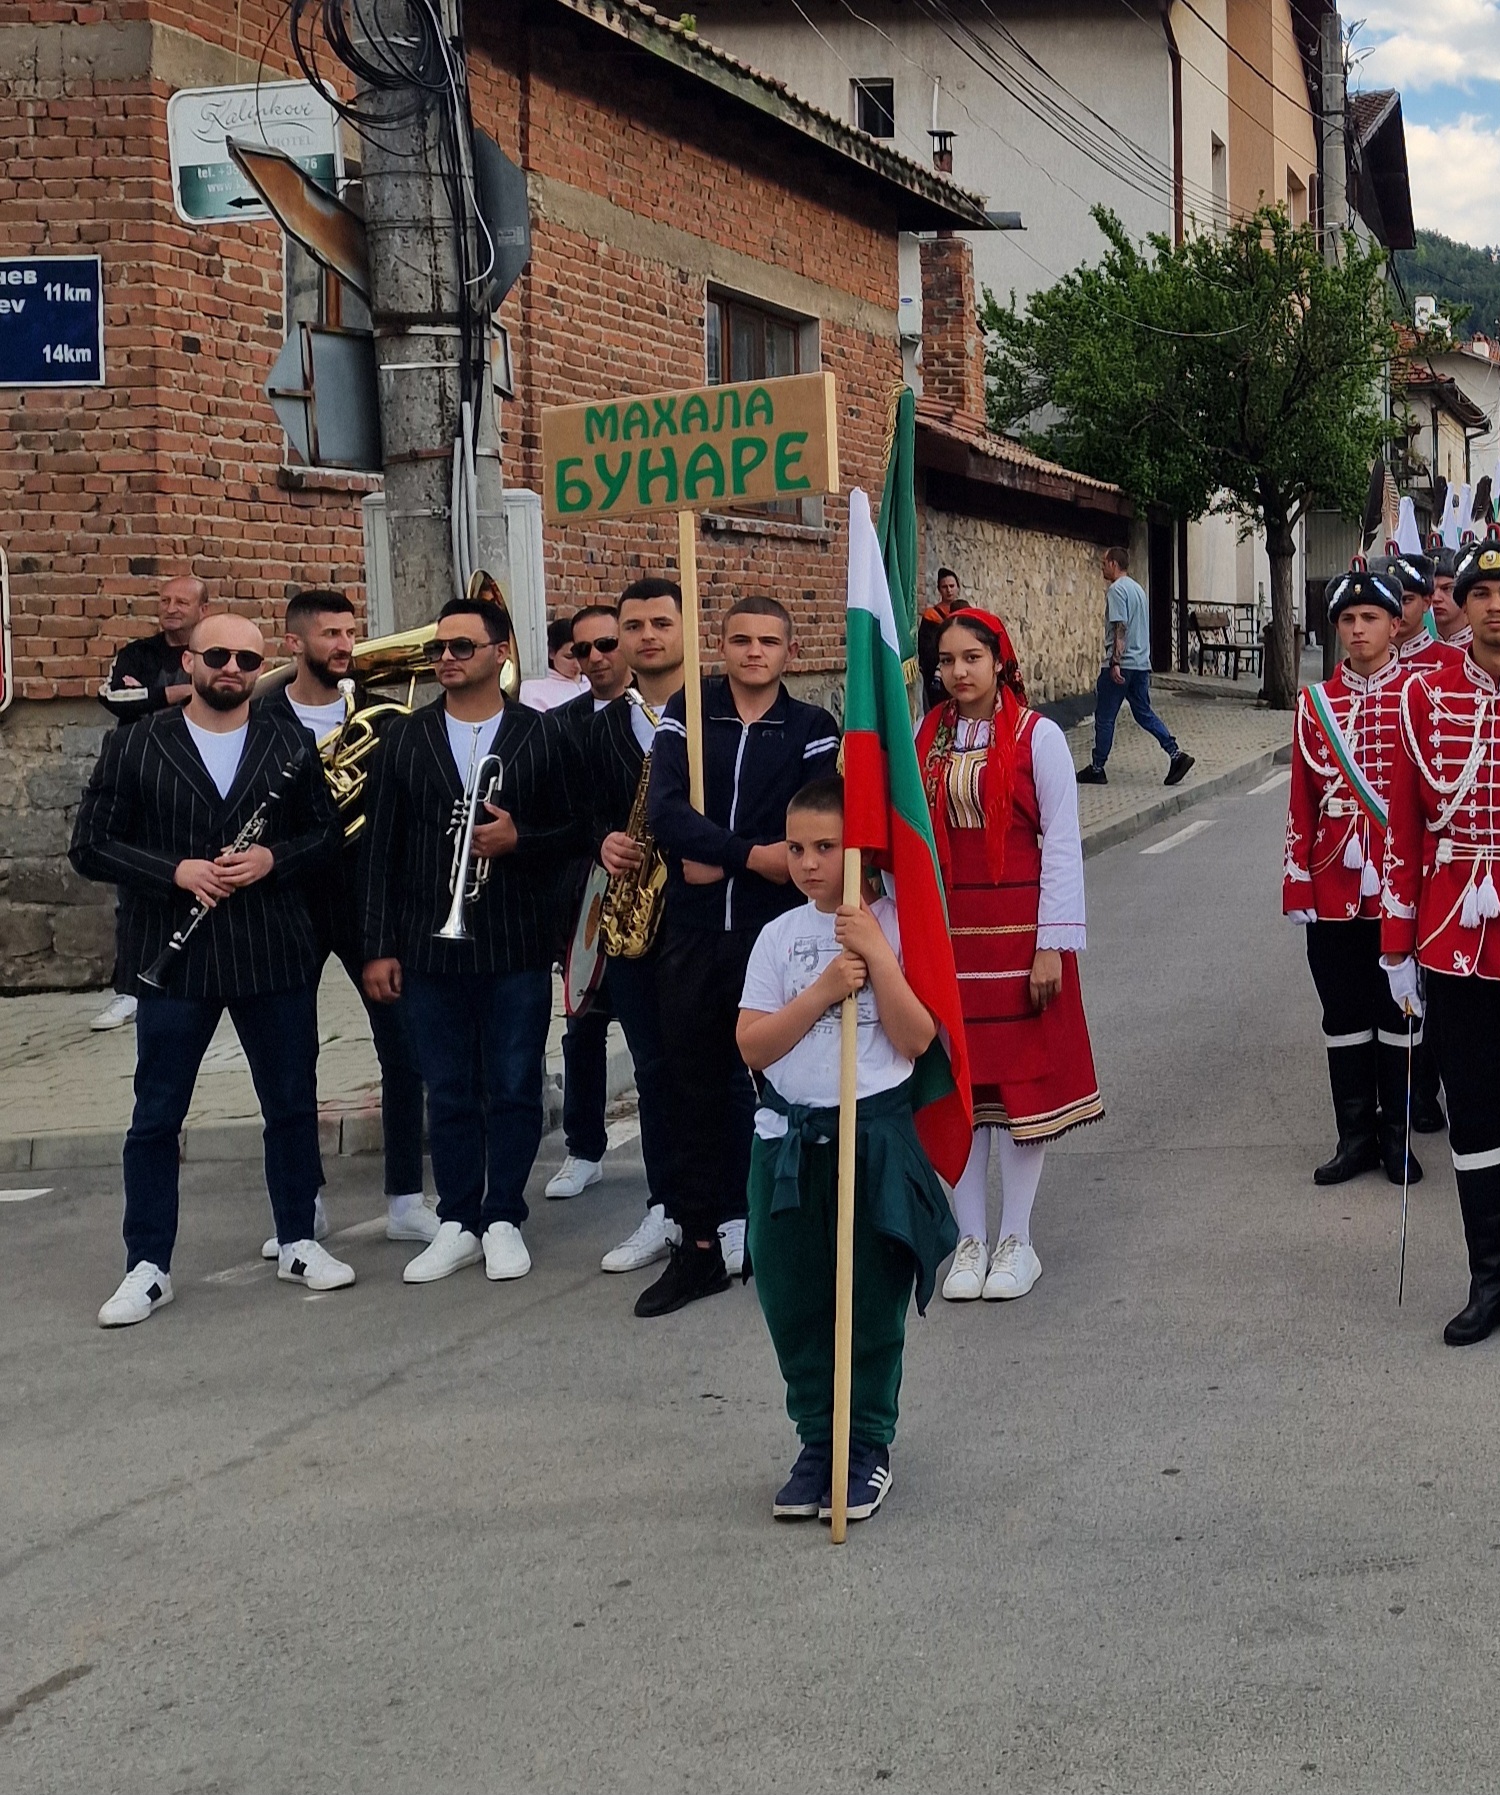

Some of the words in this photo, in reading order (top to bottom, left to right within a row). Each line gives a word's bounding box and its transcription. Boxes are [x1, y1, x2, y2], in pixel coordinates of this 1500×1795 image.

[197, 92, 314, 134] Kalinkovi
[272, 135, 312, 147] HOTEL
[197, 166, 216, 178] tel.
[304, 157, 318, 170] 76
[42, 343, 92, 363] 14km
[585, 387, 773, 444] МАХАЛА
[555, 432, 811, 513] БУНАРЕ
